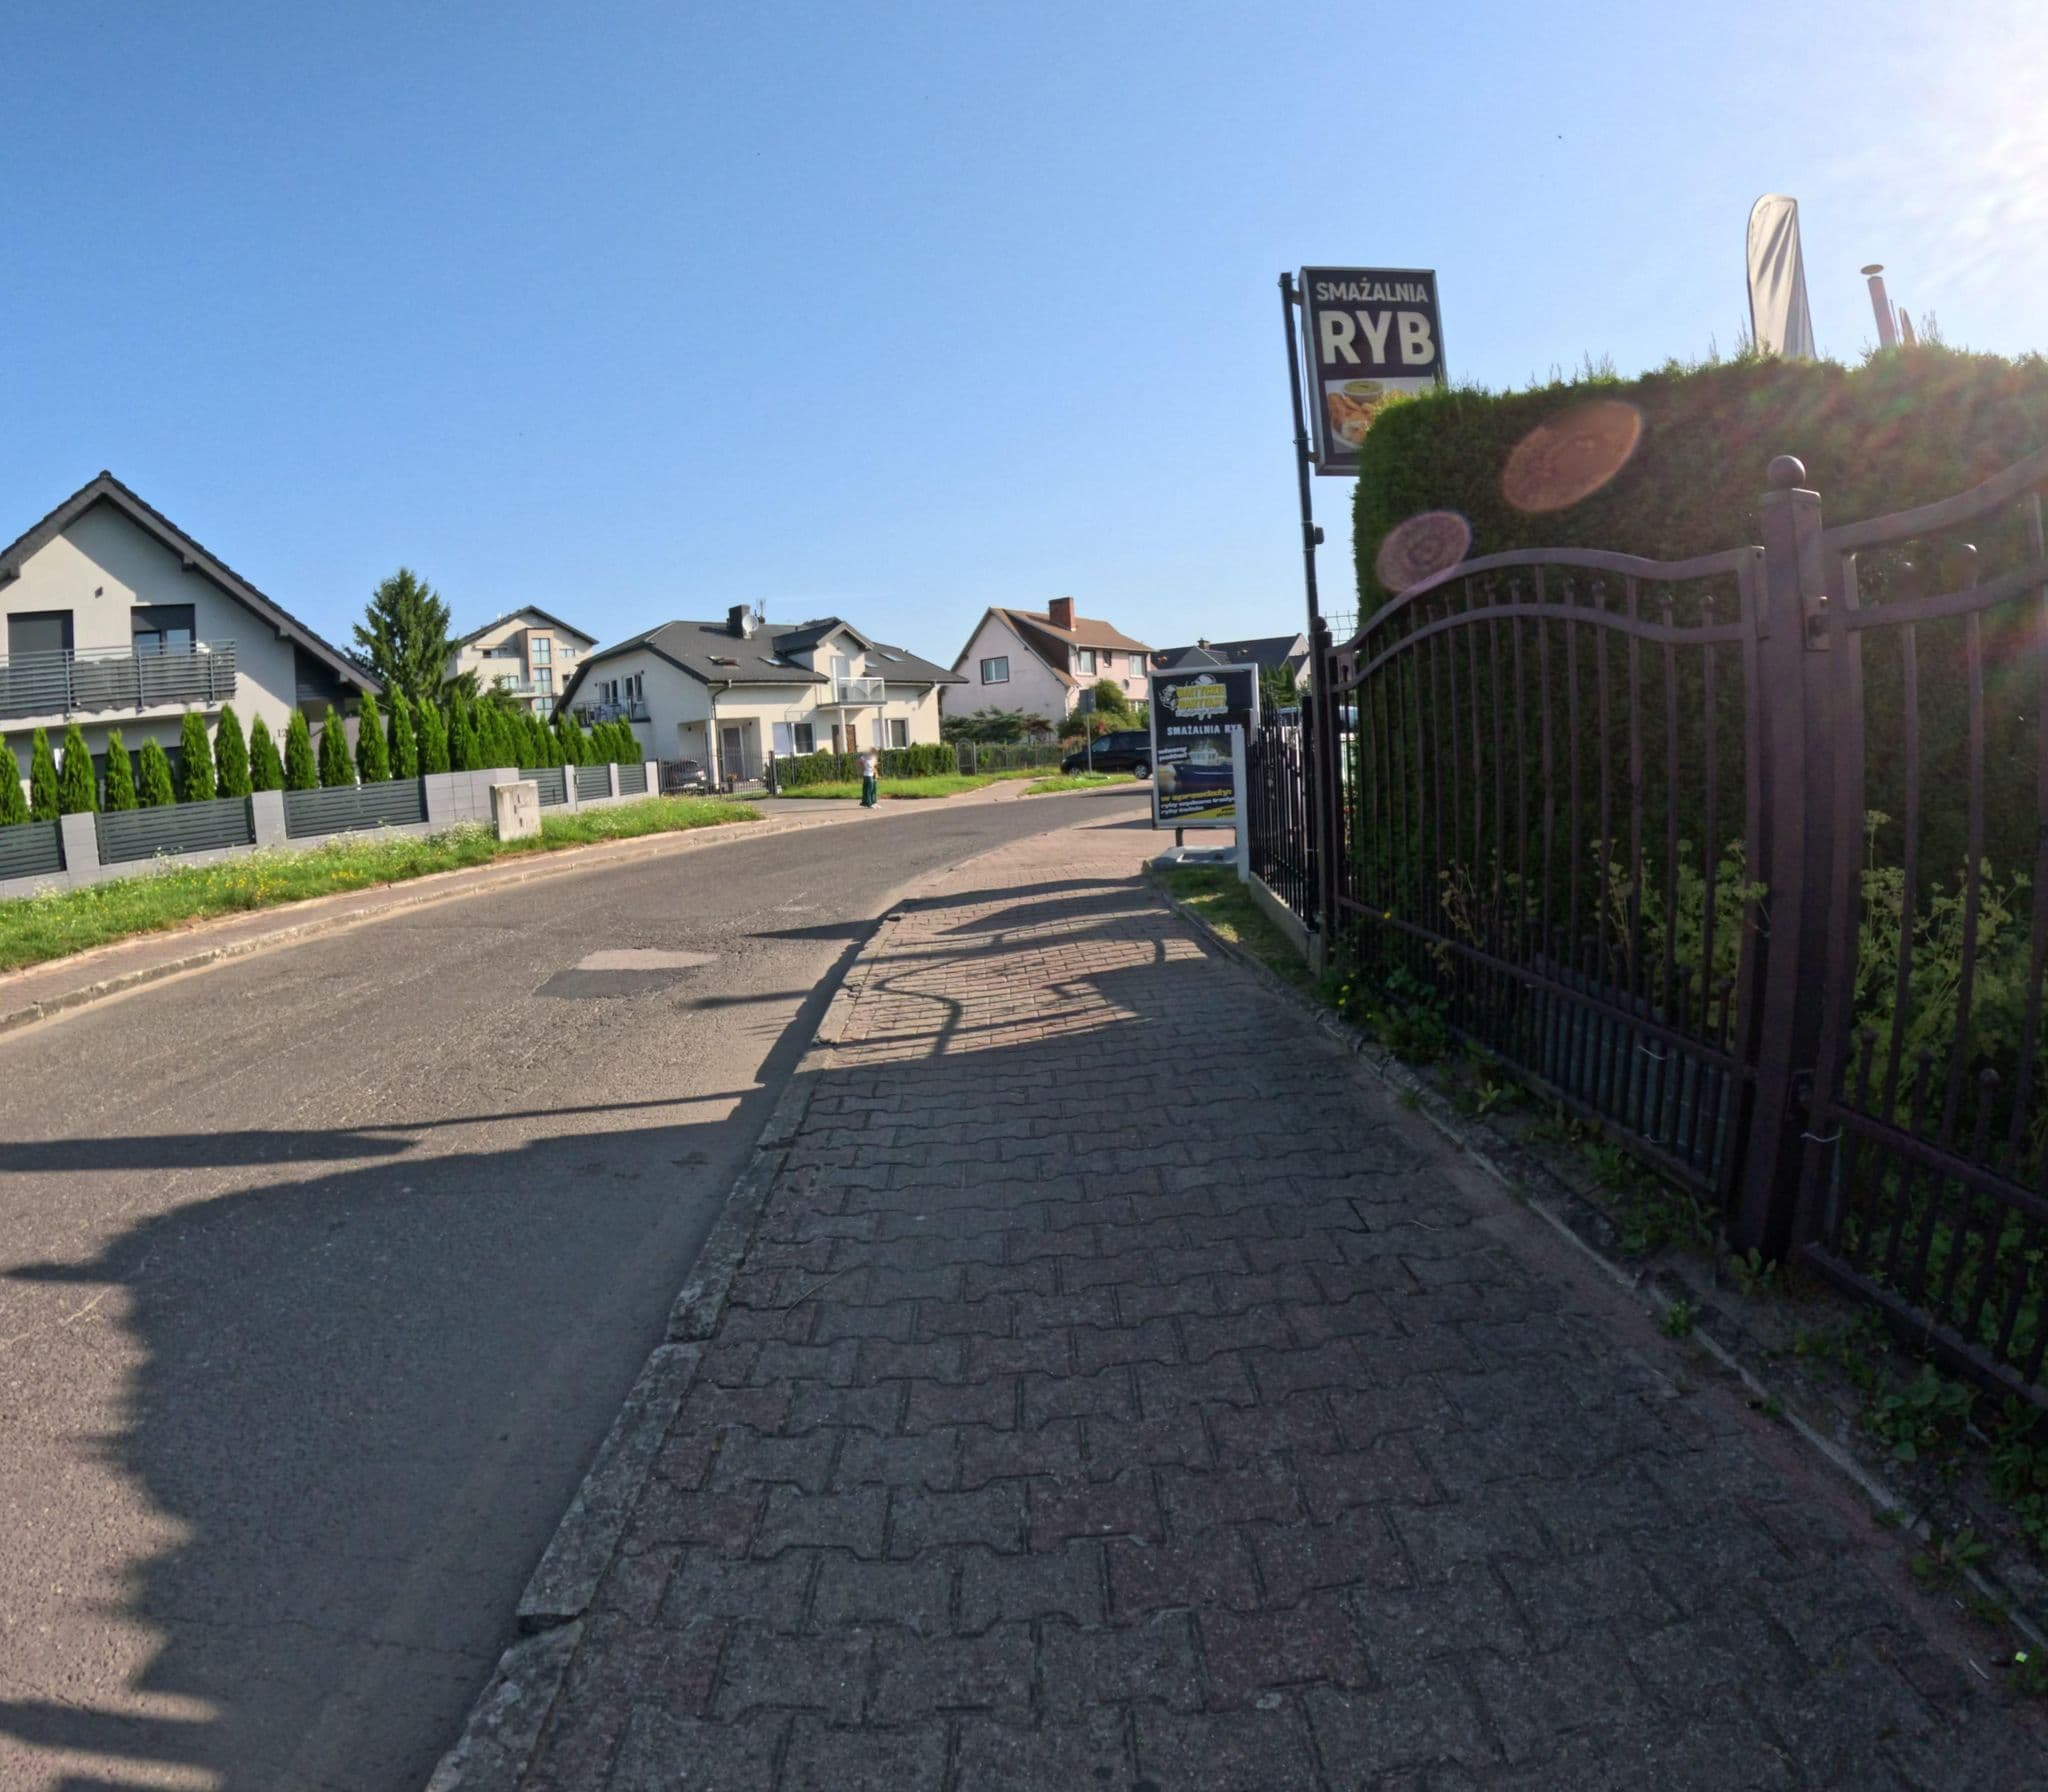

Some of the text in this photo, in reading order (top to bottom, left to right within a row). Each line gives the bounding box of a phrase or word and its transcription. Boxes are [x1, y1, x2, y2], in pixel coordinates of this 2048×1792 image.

[1316, 277, 1429, 303] SMAŻALNIA
[1318, 310, 1436, 365] RYB
[1167, 725, 1221, 736] SMAŻALNIA
